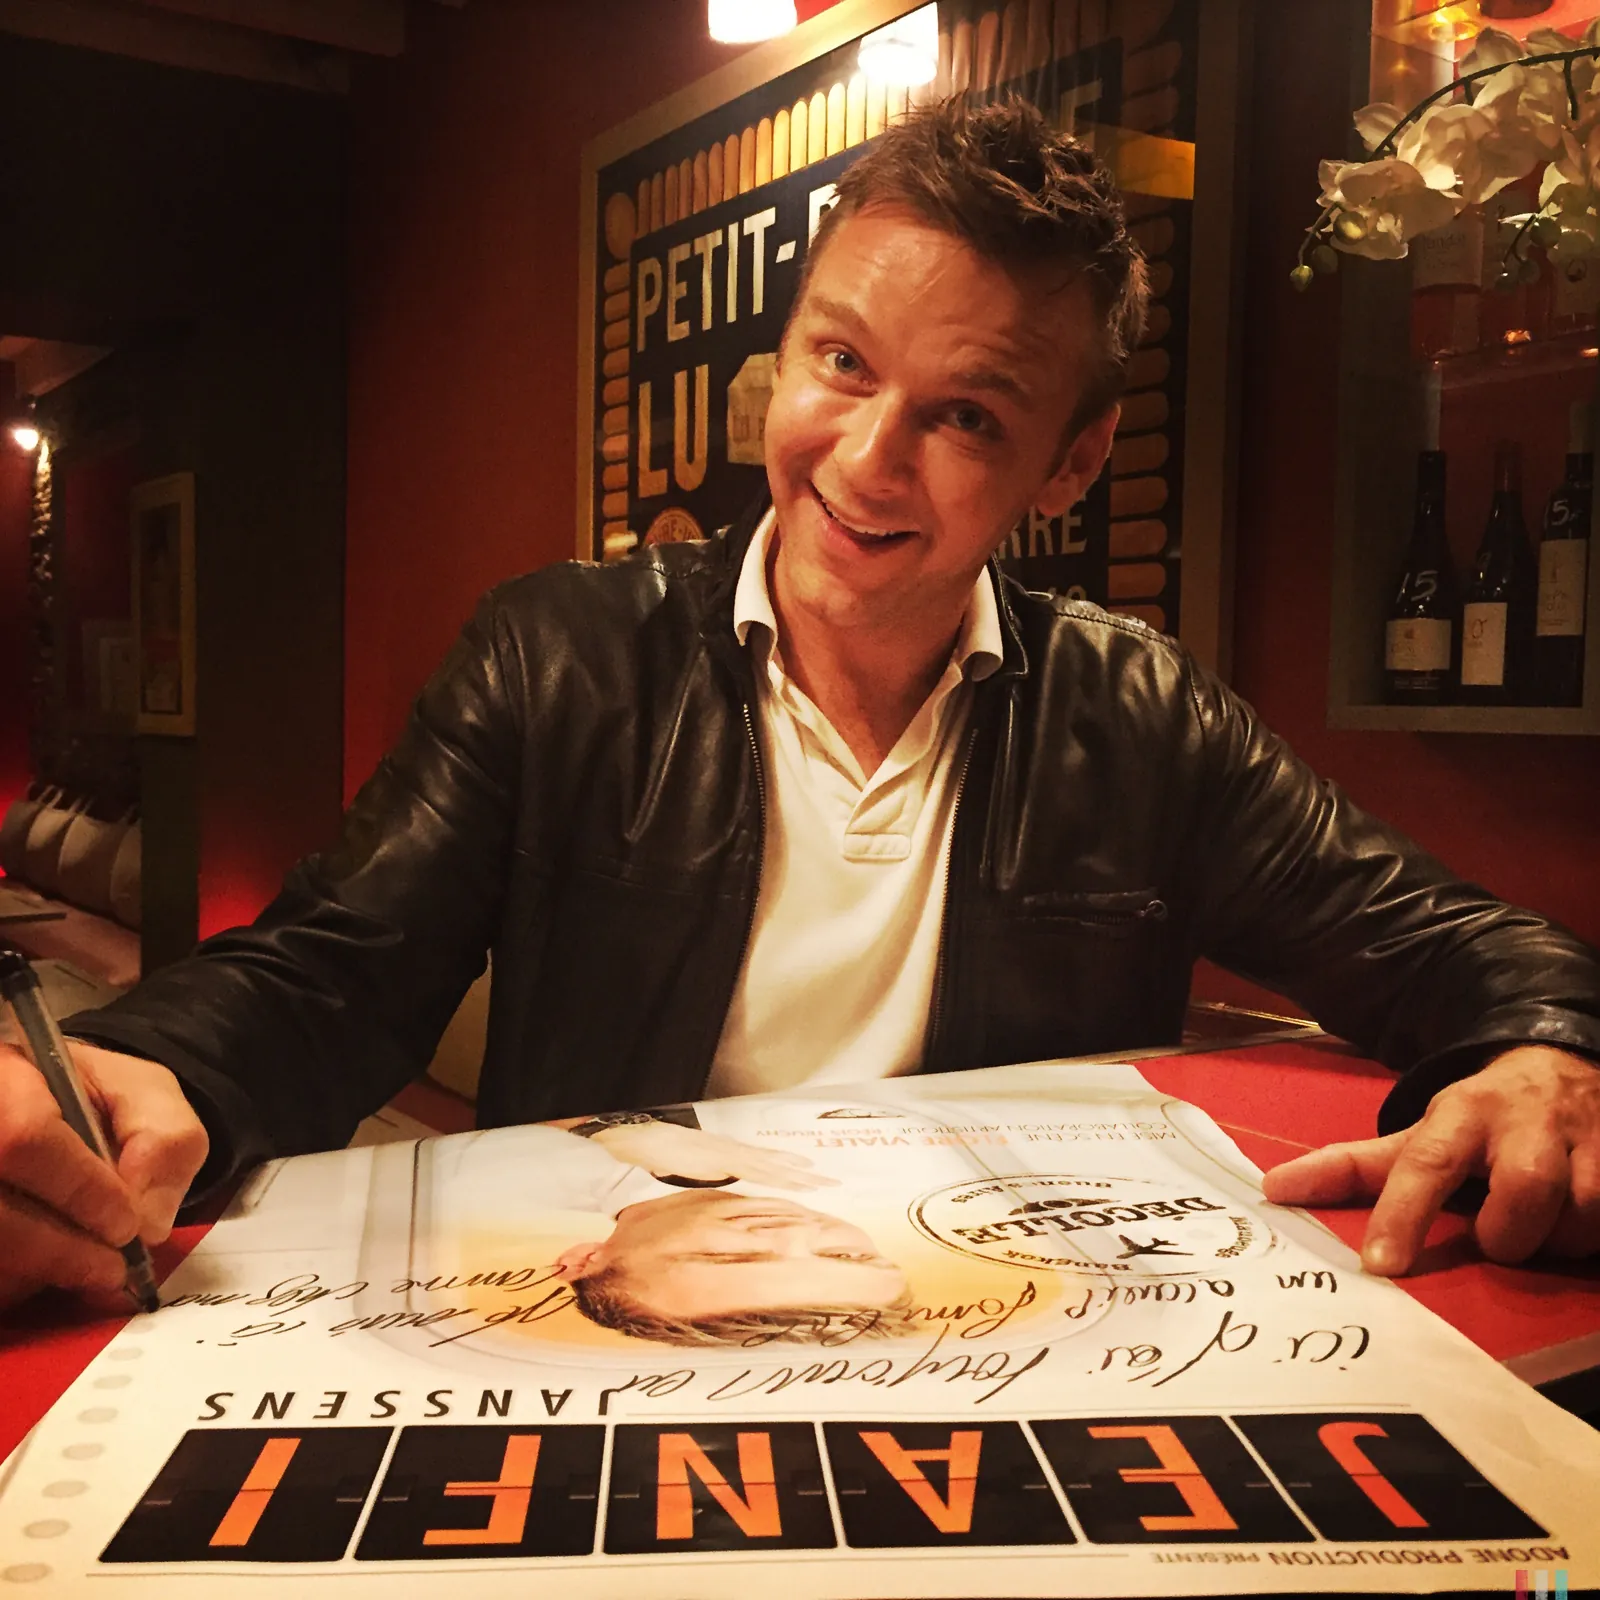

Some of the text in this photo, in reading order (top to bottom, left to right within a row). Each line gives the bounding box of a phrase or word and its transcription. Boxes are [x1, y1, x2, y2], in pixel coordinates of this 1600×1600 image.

[637, 361, 709, 498] LU
[1396, 570, 1439, 604] 15
[812, 1136, 911, 1149] VIALET
[951, 1197, 1227, 1245] DÉCOLLE
[1001, 1250, 1133, 1272] Bangkok
[1274, 1271, 1338, 1294] un
[198, 1389, 617, 1421] JANSSENS
[210, 1421, 1429, 1548] JEANFI
[1150, 1546, 1571, 1566] ADONE PRODUCTION PRÉSENTE
